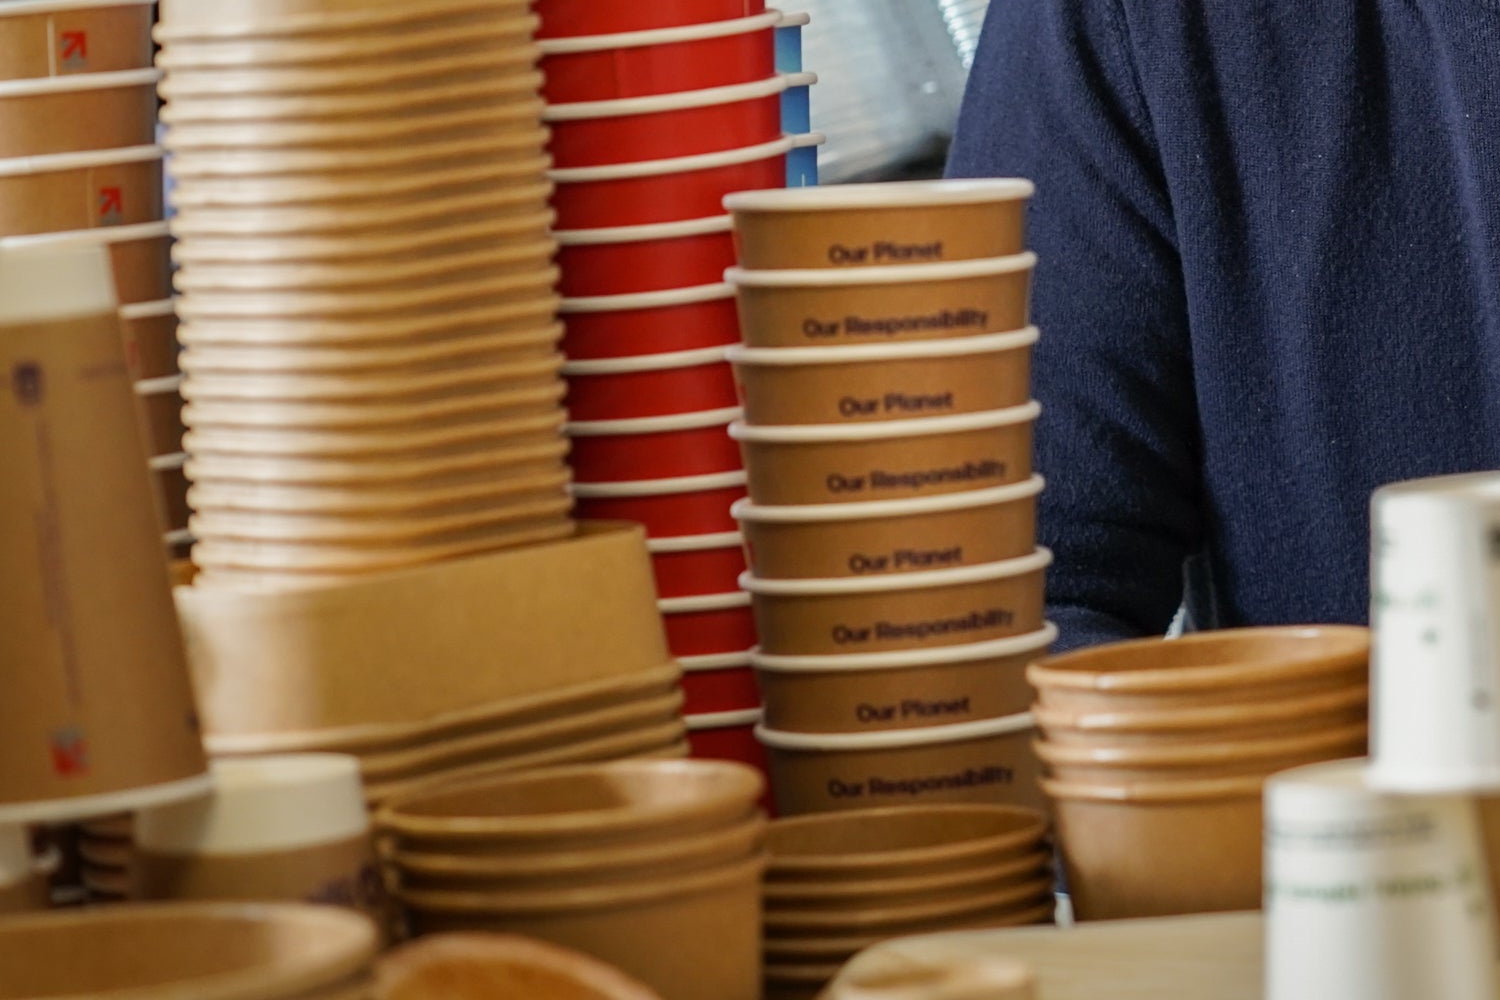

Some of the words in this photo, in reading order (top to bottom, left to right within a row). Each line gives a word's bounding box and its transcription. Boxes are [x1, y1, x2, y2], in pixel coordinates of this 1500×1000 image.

[829, 244, 868, 263] Our
[874, 241, 942, 261] Planet
[803, 317, 838, 338] Our
[846, 309, 987, 334] Responsibility
[840, 395, 879, 416] Our
[885, 392, 952, 412] Planet
[827, 472, 864, 492] Our
[871, 459, 1006, 488] Responsibility
[849, 553, 889, 573] Our
[895, 546, 962, 568] Planet
[833, 624, 870, 644] Our
[877, 609, 1013, 641] Responsibility
[856, 702, 894, 723] Our
[902, 697, 969, 718] Planet
[828, 778, 864, 798] Our
[870, 765, 1013, 796] Responsibility
